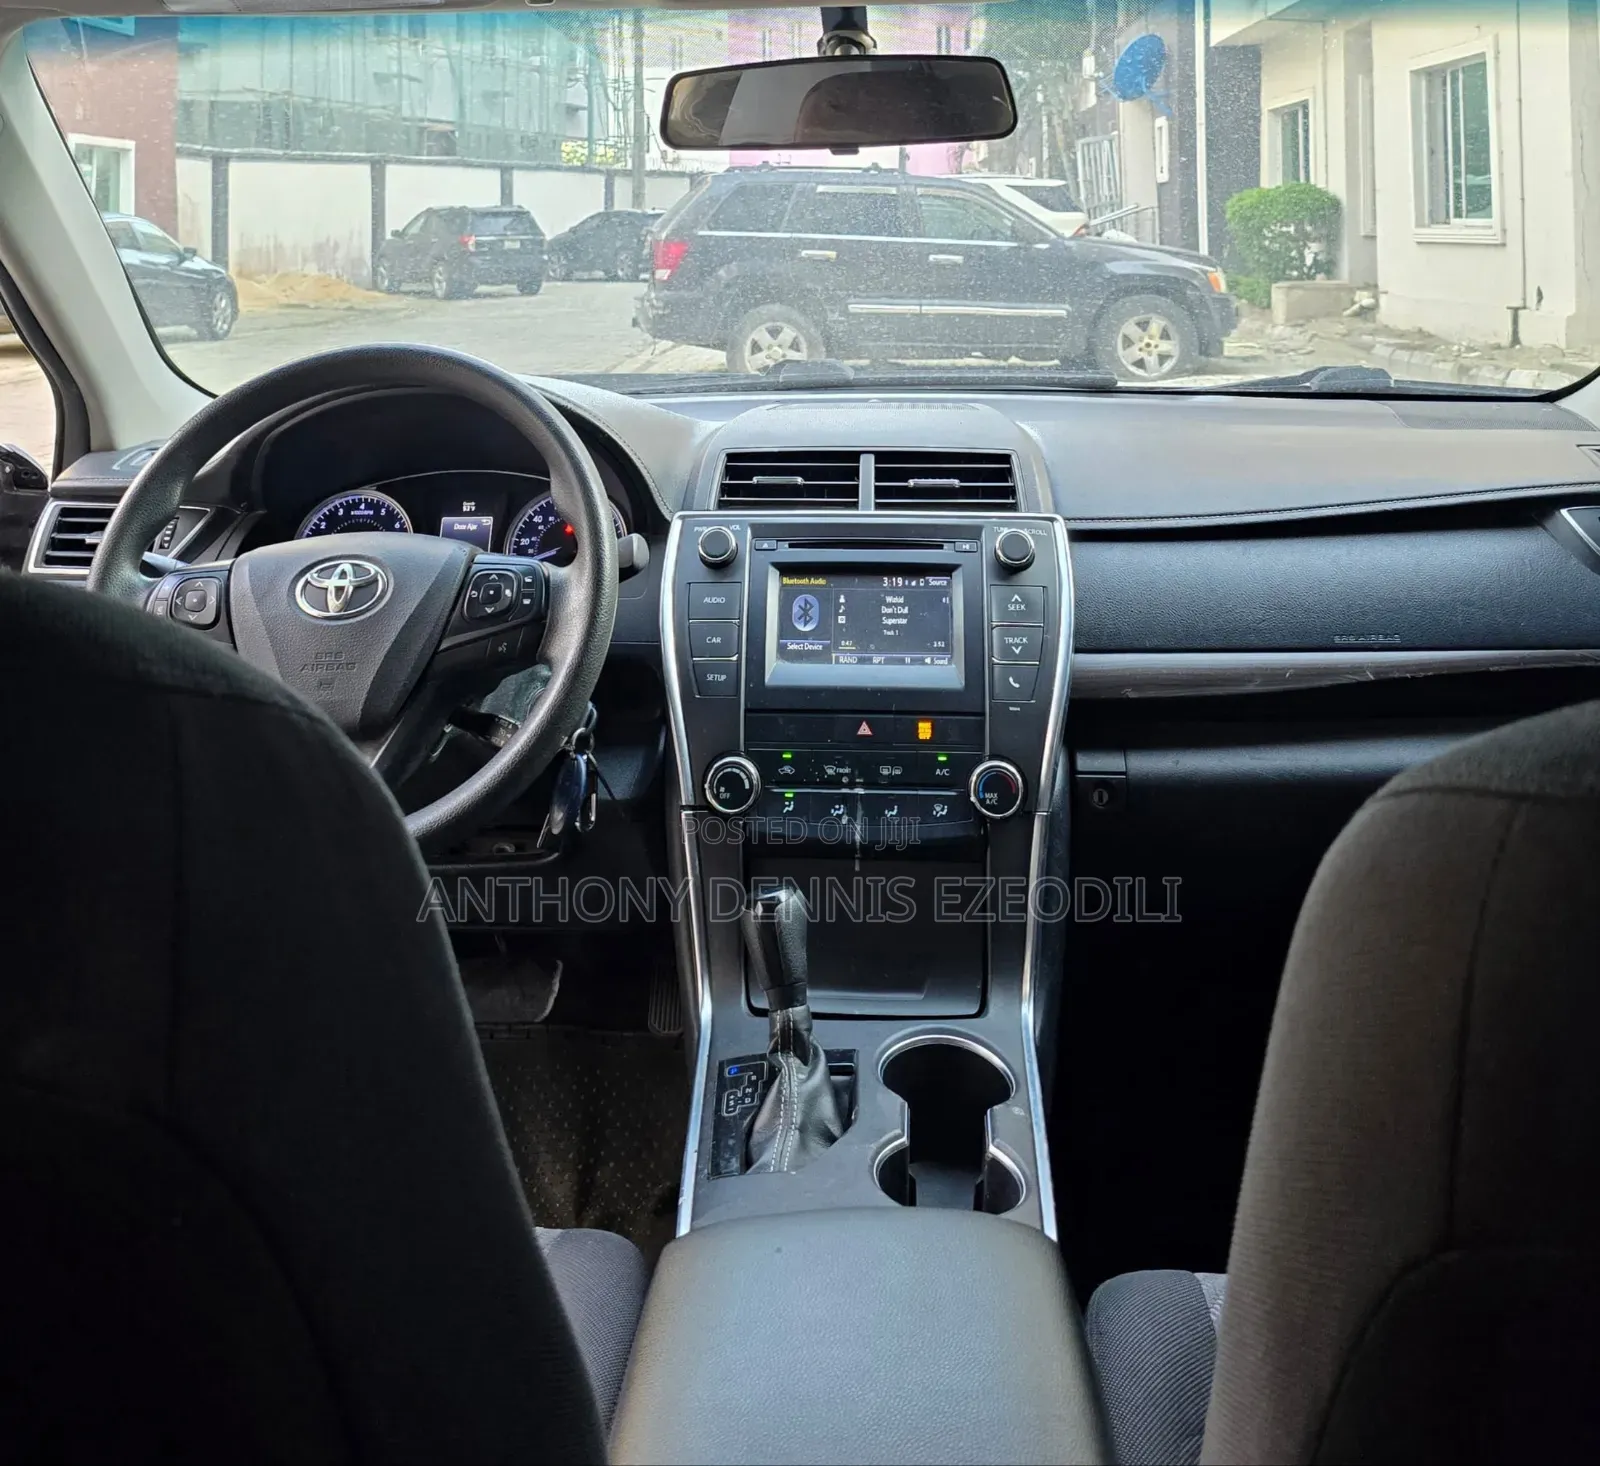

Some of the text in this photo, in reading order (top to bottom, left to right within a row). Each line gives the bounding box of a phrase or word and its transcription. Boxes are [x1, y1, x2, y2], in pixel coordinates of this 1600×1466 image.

[782, 577, 827, 585] Bluetooth Audio
[882, 577, 903, 587] 3:19
[928, 578, 948, 587] Source
[881, 606, 909, 614] Don't Dull
[881, 617, 908, 625] Superstar
[706, 636, 722, 644] CAR
[786, 642, 823, 651] Select Device
[839, 656, 858, 664] RAND
[872, 656, 885, 664] RPT
[706, 674, 727, 682] SETUP
[935, 768, 950, 776] A/C
[719, 792, 731, 800] OFF
